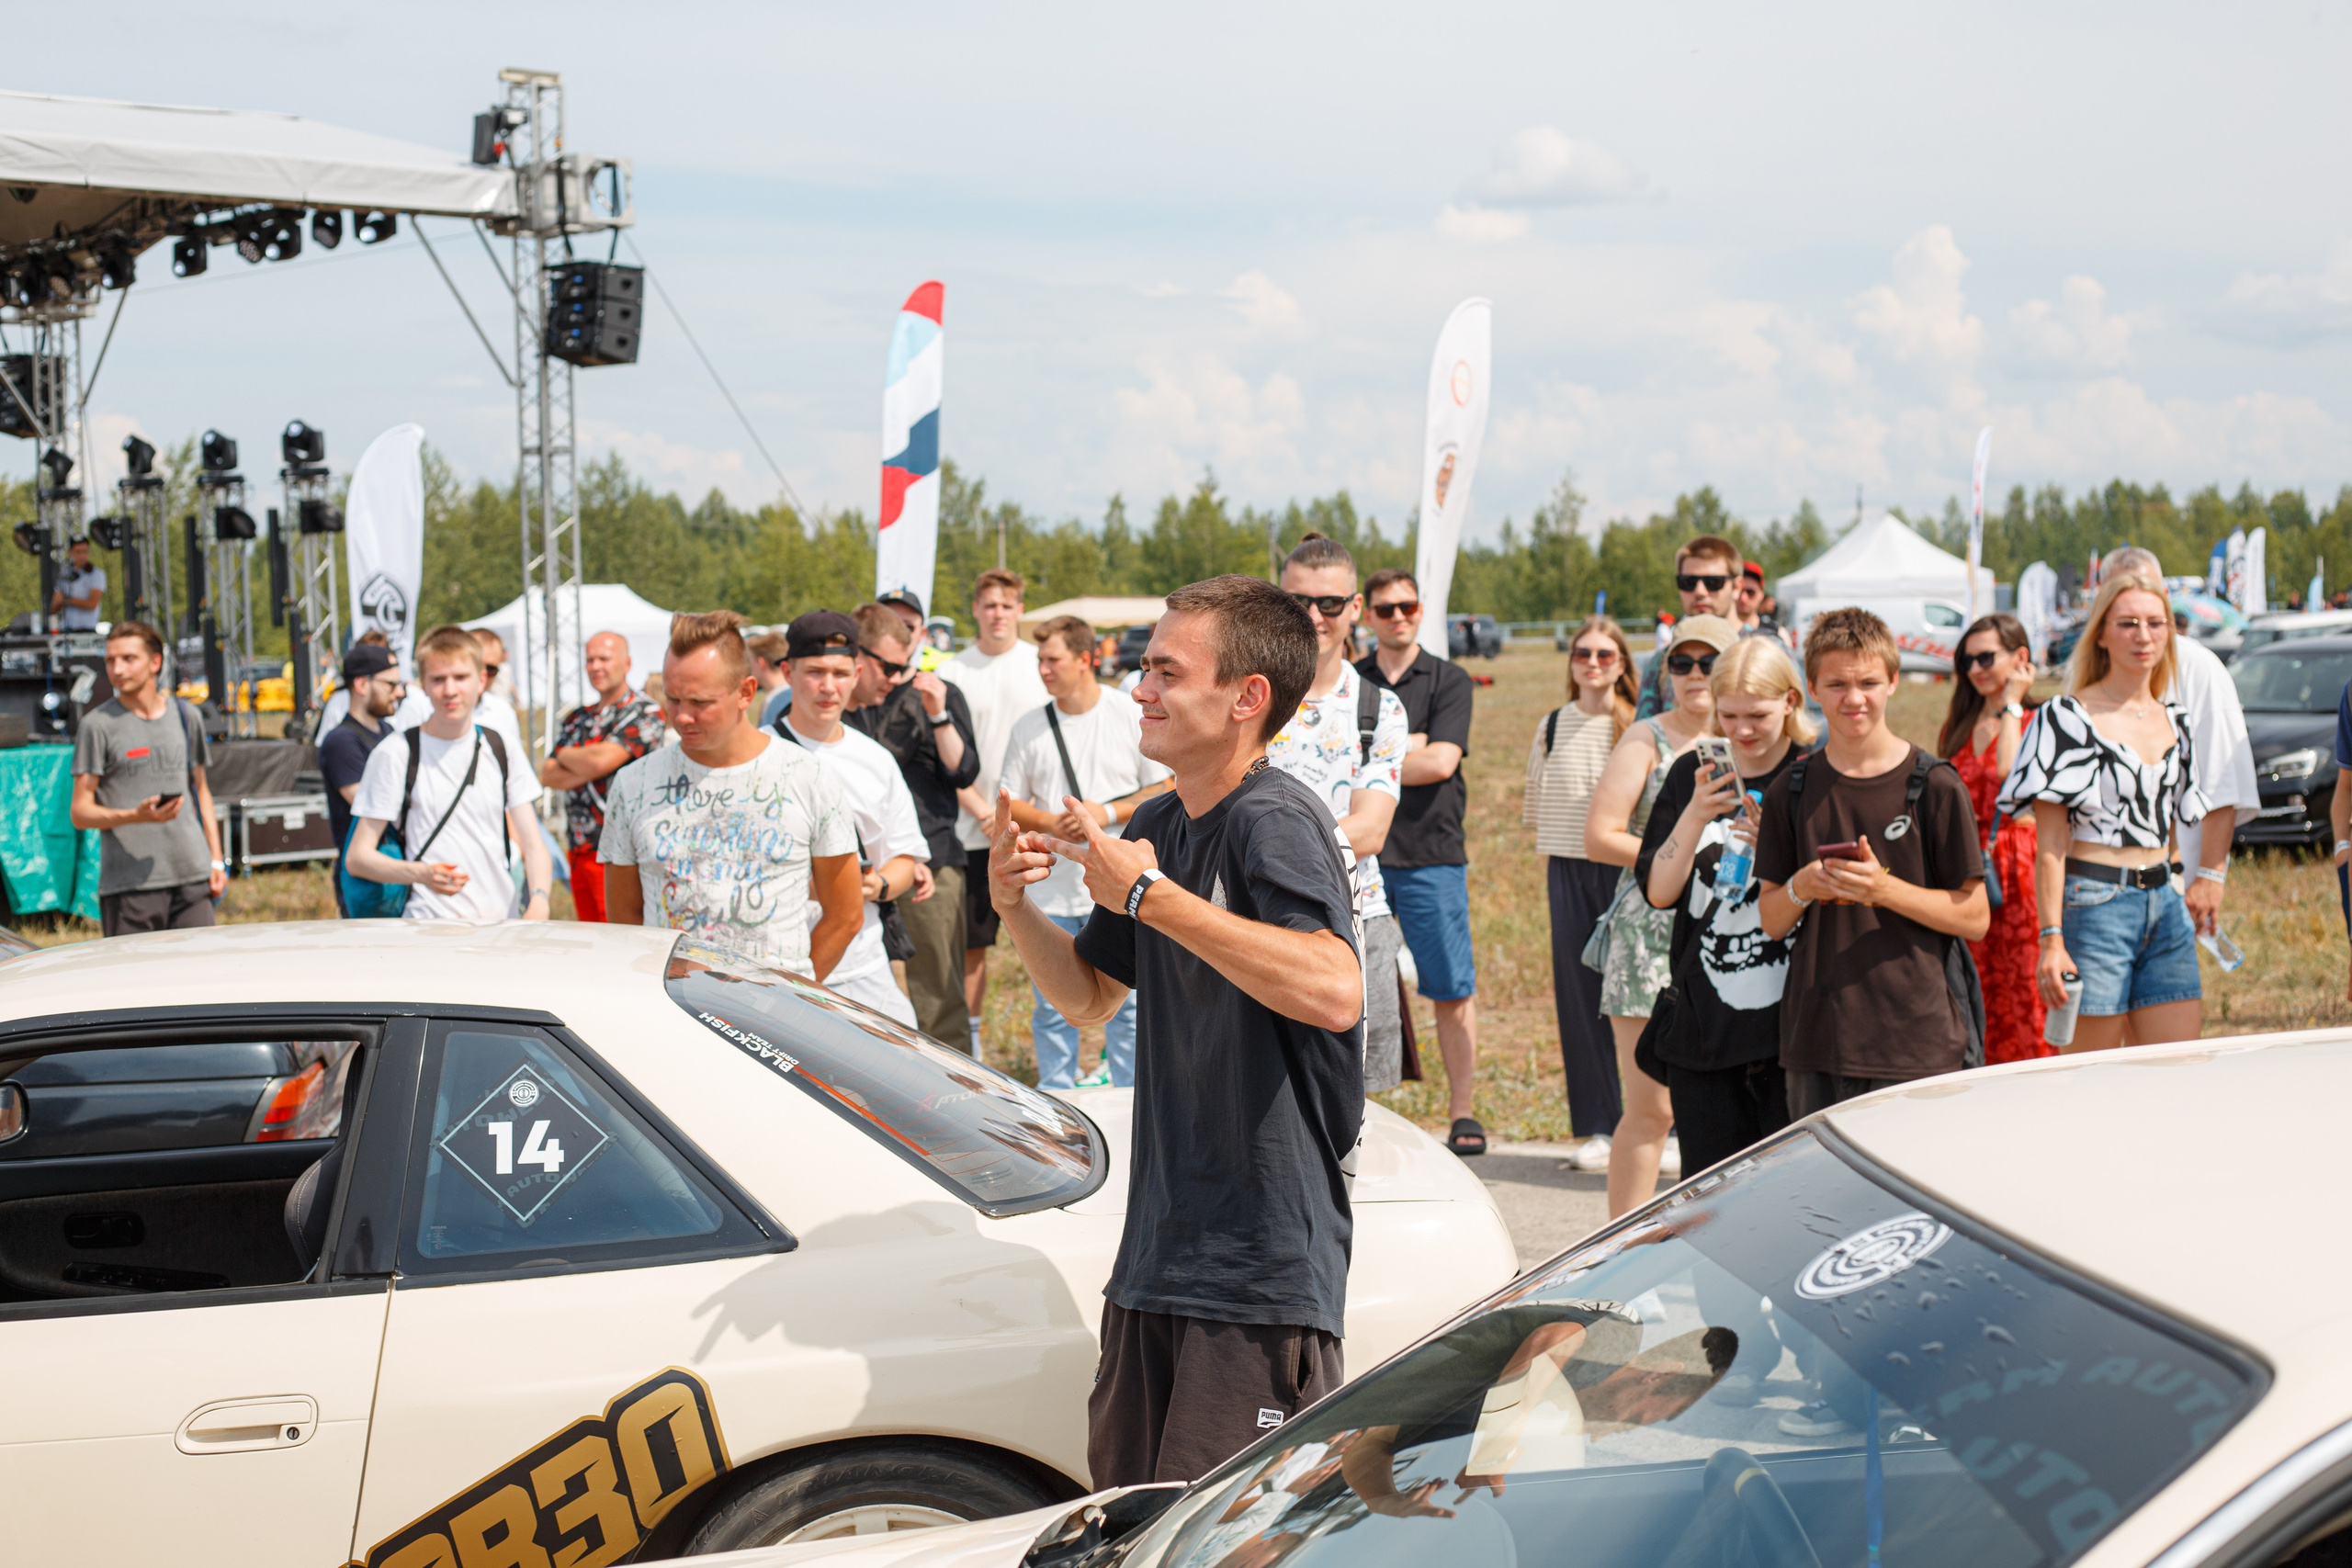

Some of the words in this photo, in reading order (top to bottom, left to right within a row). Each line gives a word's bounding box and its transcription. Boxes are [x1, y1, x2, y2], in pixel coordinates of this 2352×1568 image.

[698, 1011, 796, 1073] BLACKFISH
[746, 1032, 774, 1049] TEAM
[771, 1047, 800, 1066] DRIFT
[488, 1119, 565, 1175] 14
[1261, 1411, 1282, 1421] PUMA
